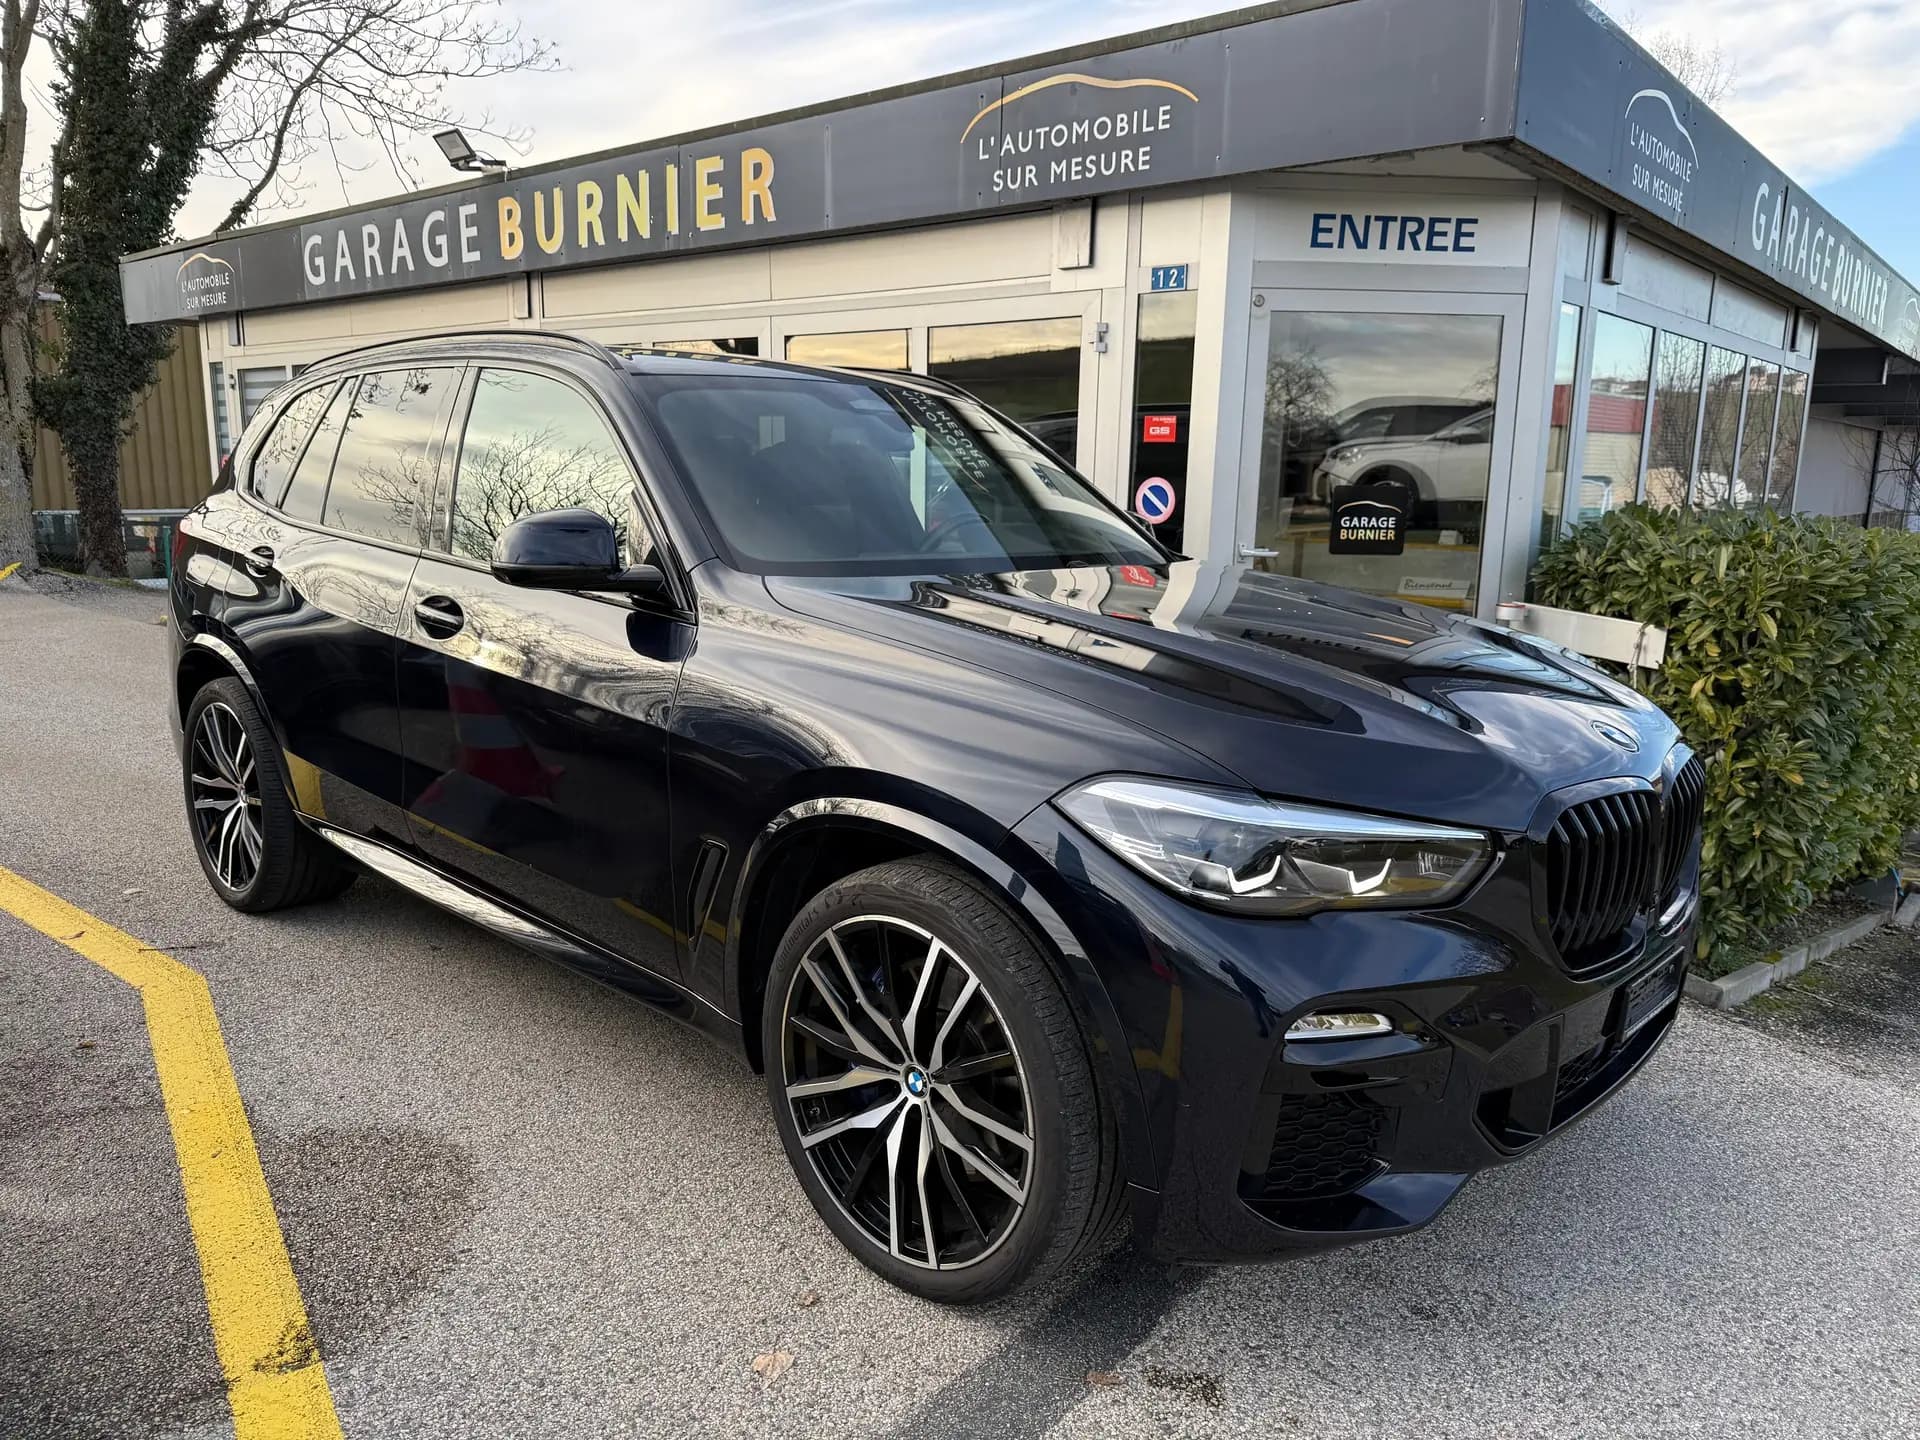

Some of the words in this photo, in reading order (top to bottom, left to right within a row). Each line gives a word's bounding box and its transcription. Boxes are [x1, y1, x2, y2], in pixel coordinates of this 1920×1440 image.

[977, 104, 1171, 161] L'AUTOMOBILE
[1630, 122, 1692, 183] L'AUTOMOBILE
[992, 164, 1038, 192] SUR
[1050, 146, 1151, 183] MESURE
[1632, 163, 1651, 194] SUR
[1652, 176, 1684, 213] MESURE
[304, 203, 481, 286] GARAGE
[498, 147, 777, 260] BURNIER
[1310, 213, 1479, 253] ENTREE
[1751, 182, 1836, 293] GARAGE
[1831, 243, 1888, 330] BURNIER
[181, 272, 230, 294] L'AUTOMOBILE
[1157, 268, 1178, 288] 12
[186, 295, 200, 309] SUR
[200, 291, 227, 308] MESURE
[1340, 516, 1397, 528] GARAGE
[1340, 528, 1396, 540] BURNIER
